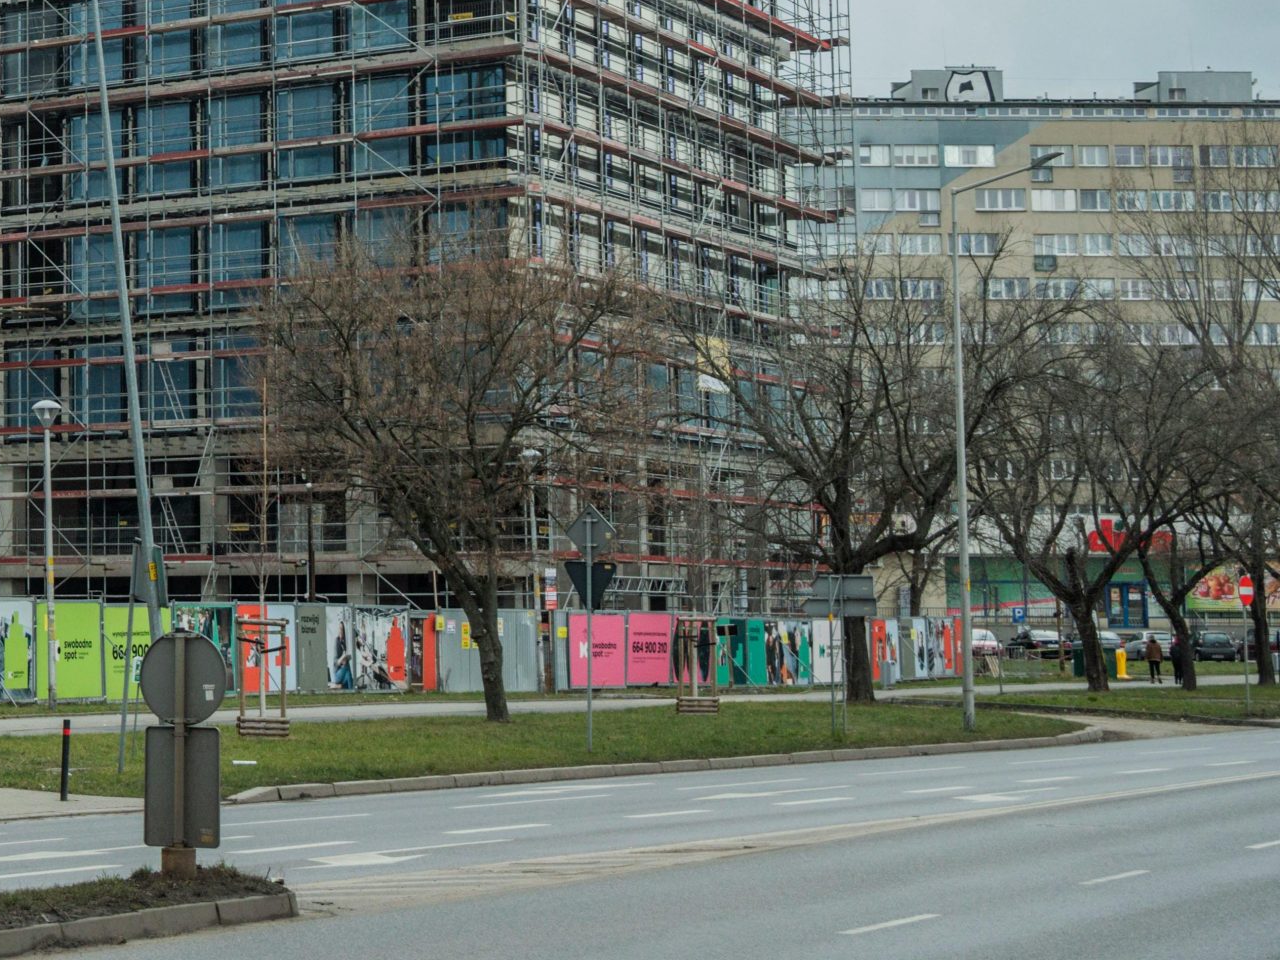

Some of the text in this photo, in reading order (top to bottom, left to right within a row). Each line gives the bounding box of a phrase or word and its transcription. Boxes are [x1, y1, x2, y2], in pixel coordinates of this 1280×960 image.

[64, 639, 92, 648] swobodna
[632, 641, 667, 653] 664 900 310
[64, 650, 77, 661] spot
